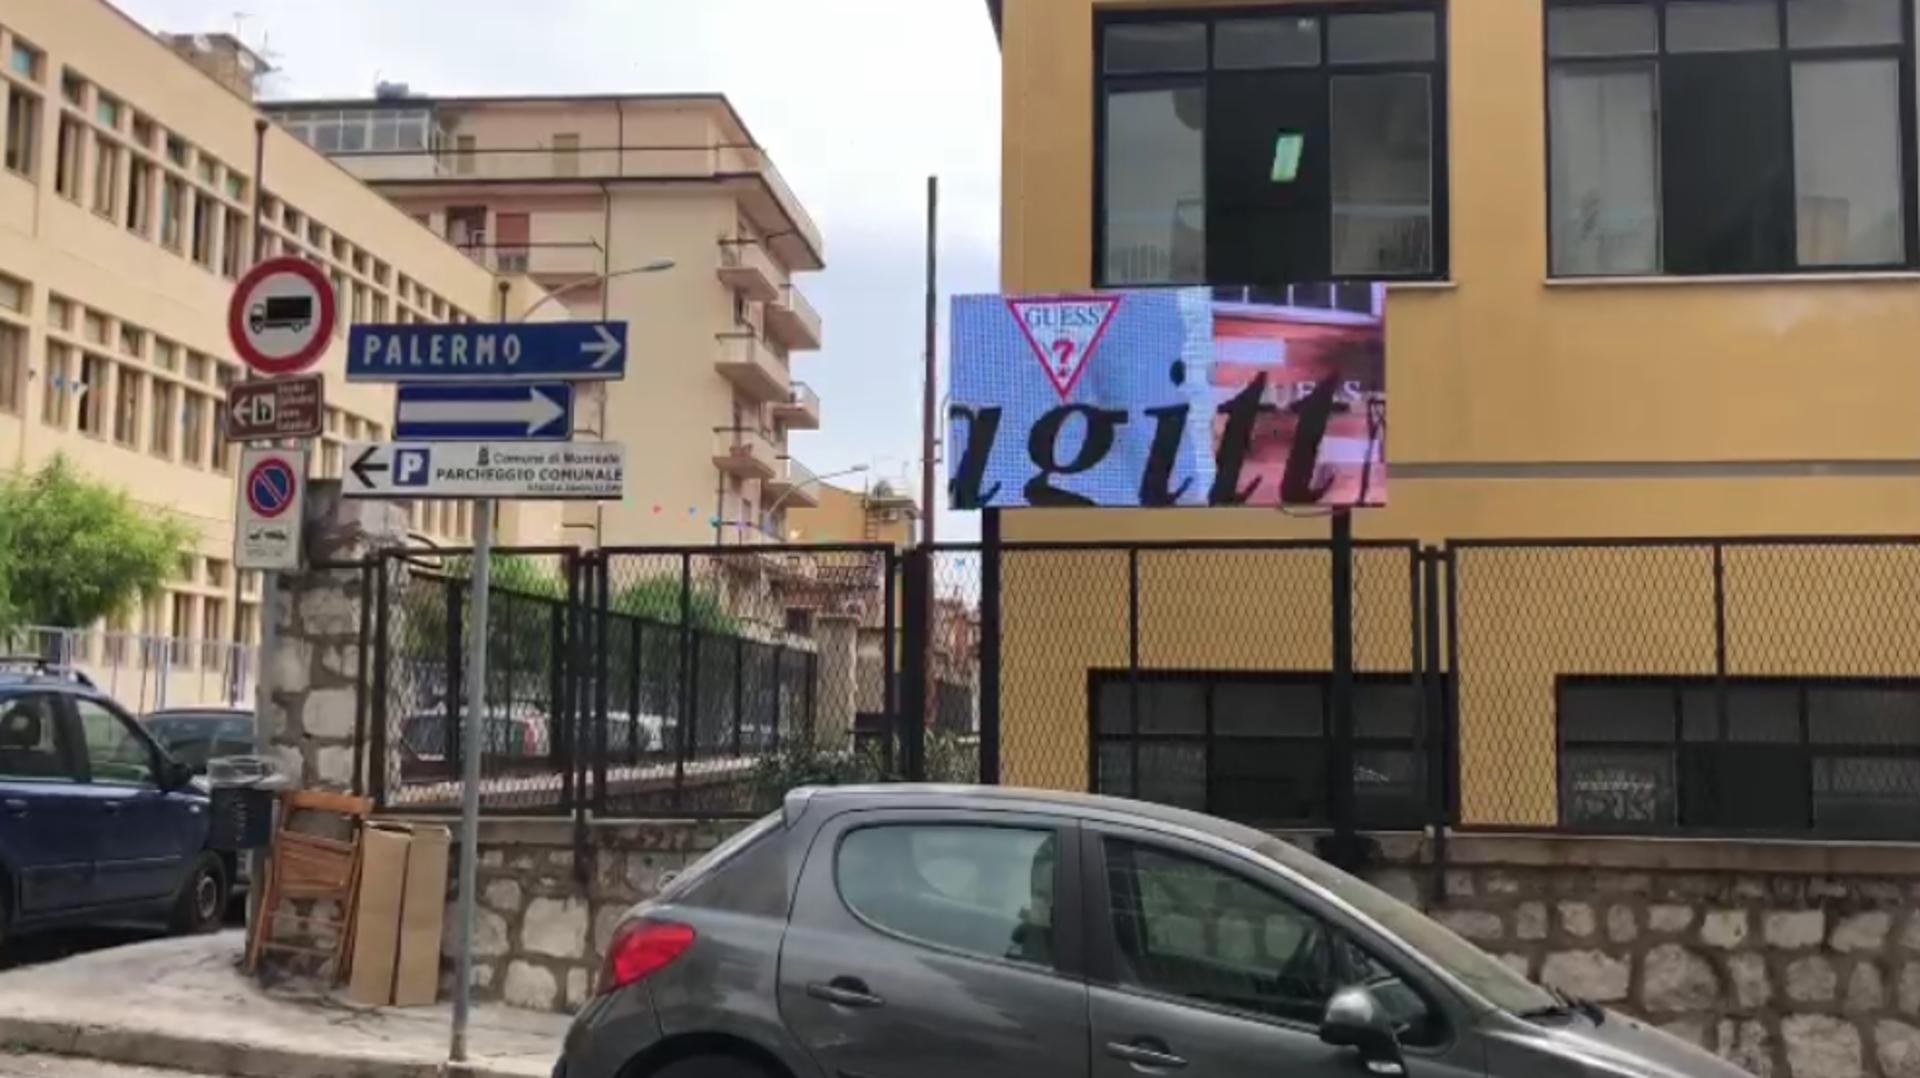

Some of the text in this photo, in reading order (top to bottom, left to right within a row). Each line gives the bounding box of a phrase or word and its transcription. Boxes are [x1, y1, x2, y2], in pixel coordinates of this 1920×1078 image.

[1024, 306, 1100, 327] GUESS
[363, 333, 521, 366] PALERMO
[399, 451, 424, 482] P
[436, 467, 623, 482] PARCHEGGIO COMUNALE
